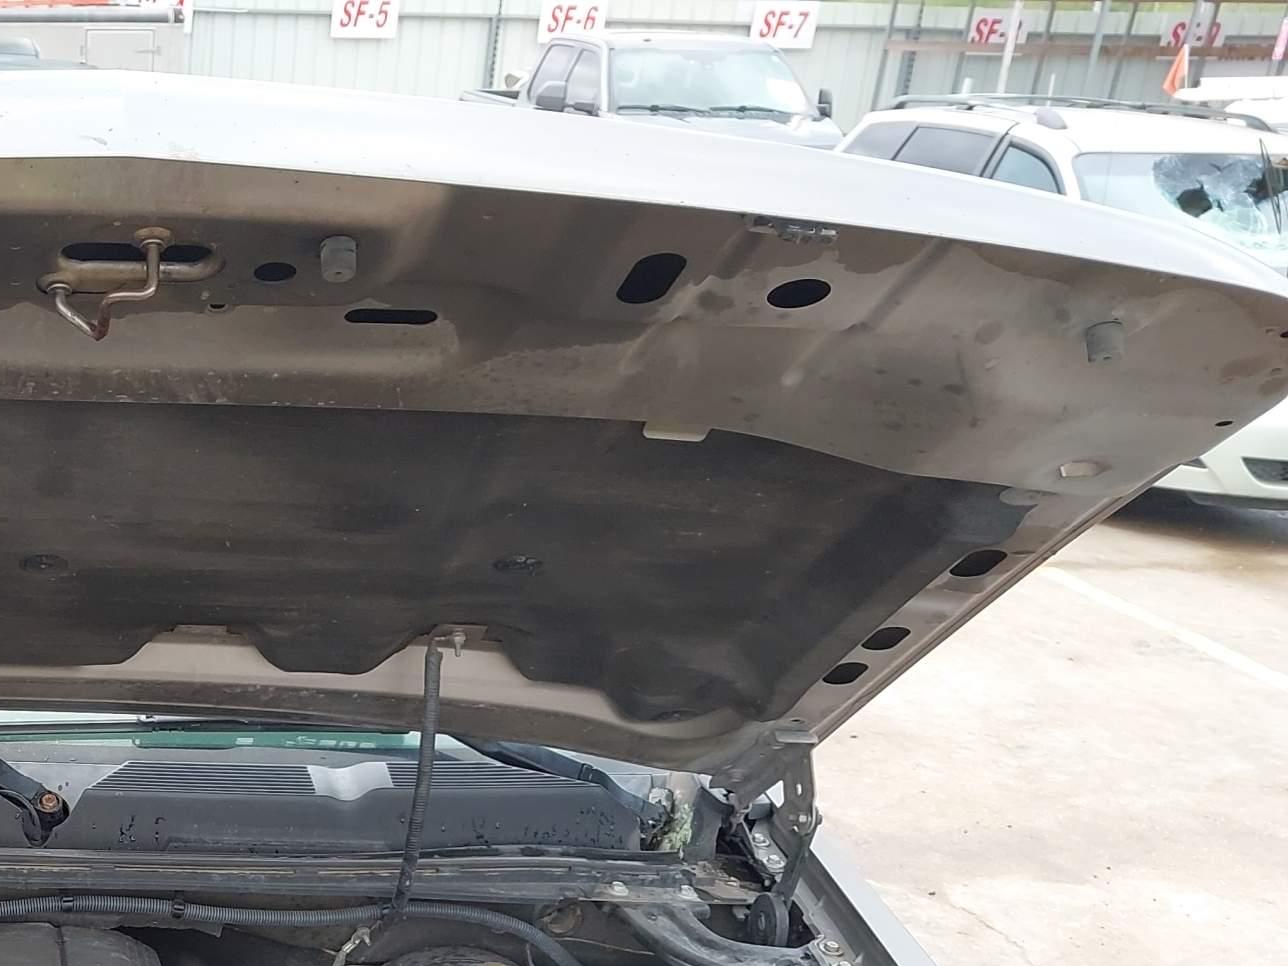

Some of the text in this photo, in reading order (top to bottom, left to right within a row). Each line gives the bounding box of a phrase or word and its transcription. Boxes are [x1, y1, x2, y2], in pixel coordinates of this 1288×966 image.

[340, 0, 391, 28] SF-5
[547, 5, 599, 33] SF-6
[759, 10, 810, 38] SF-7
[971, 17, 1022, 43] SF-
